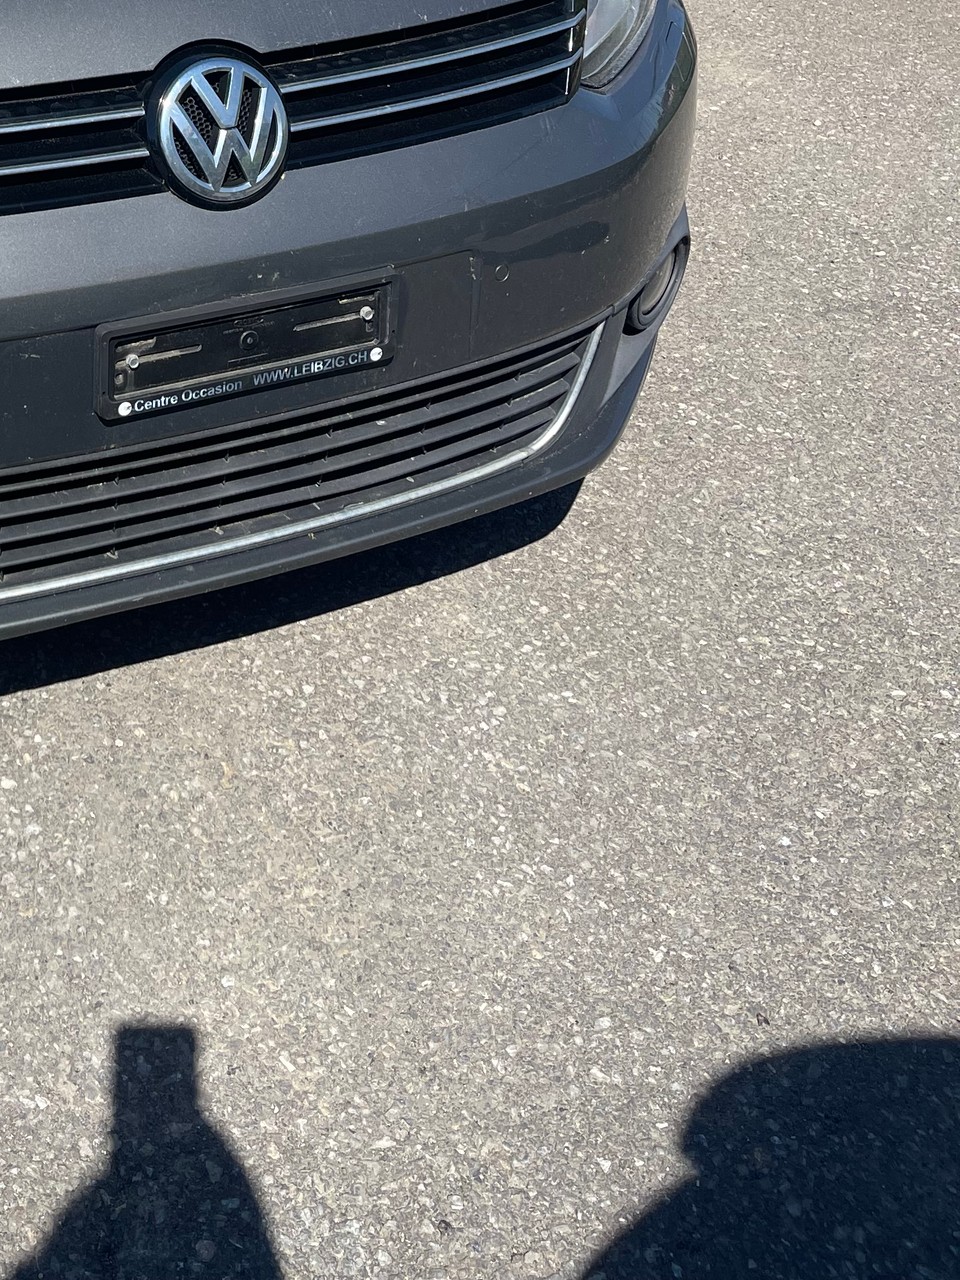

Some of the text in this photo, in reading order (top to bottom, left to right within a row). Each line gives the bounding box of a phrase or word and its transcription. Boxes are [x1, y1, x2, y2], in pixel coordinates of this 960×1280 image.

[160, 58, 288, 201] VW
[134, 350, 368, 412] Centre Occasion WWW.LEIBZIG.CH
